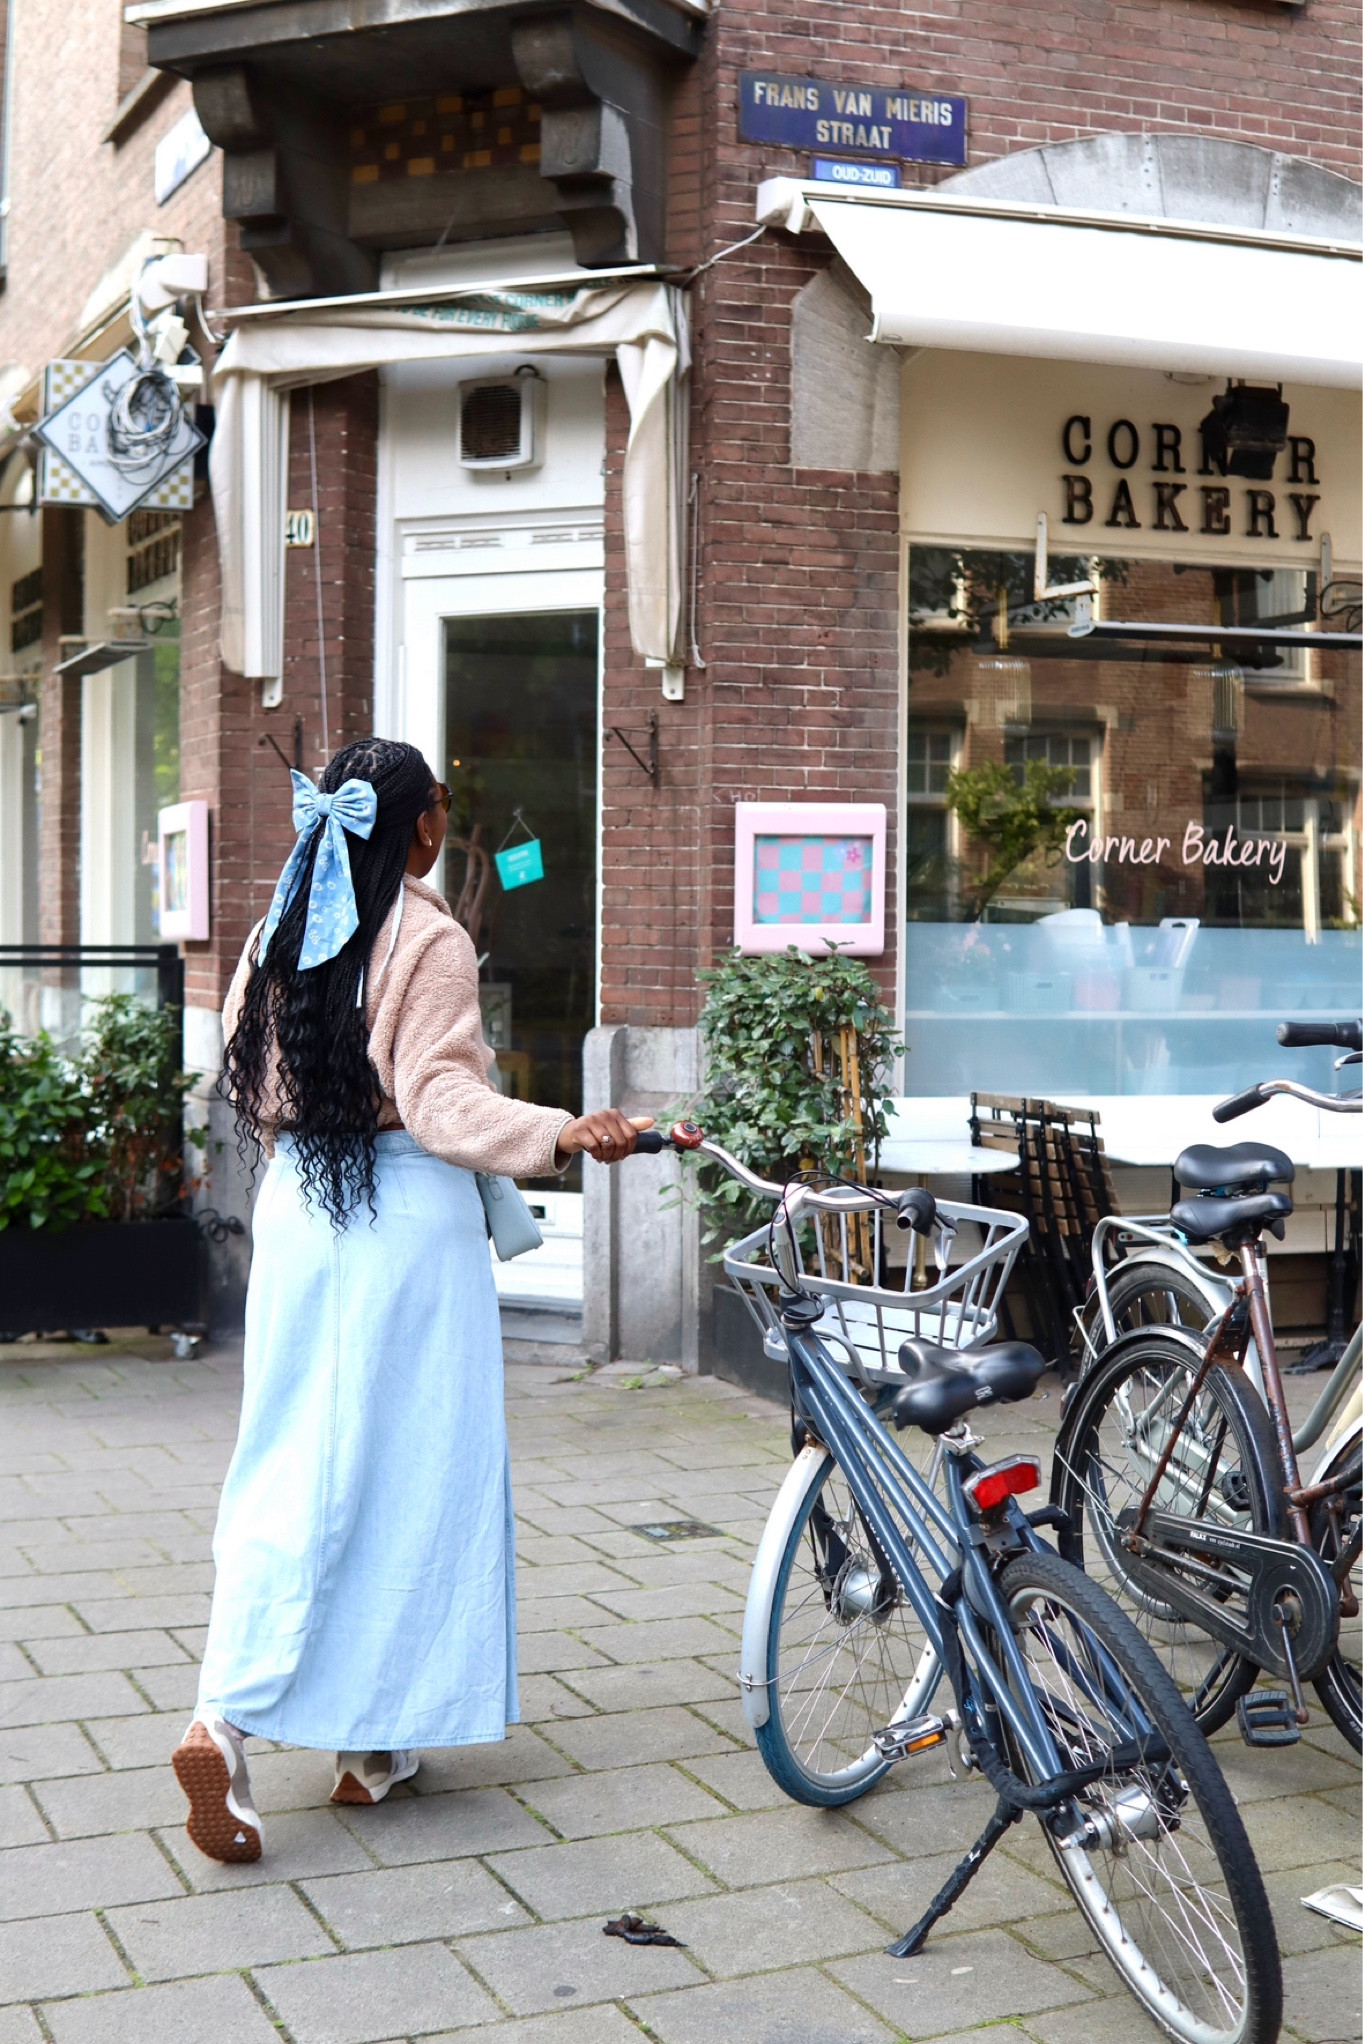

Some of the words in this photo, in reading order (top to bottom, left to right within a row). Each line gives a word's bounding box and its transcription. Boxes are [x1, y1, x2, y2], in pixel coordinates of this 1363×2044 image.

[754, 81, 820, 111] FRANS
[832, 90, 872, 117] VAN
[886, 96, 953, 127] MIERIS
[816, 119, 893, 150] STRAAT
[831, 165, 892, 185] OUD-ZUID
[1061, 473, 1321, 542] BAKERY
[1065, 818, 1171, 863] Corner
[1181, 820, 1287, 885] Bakery
